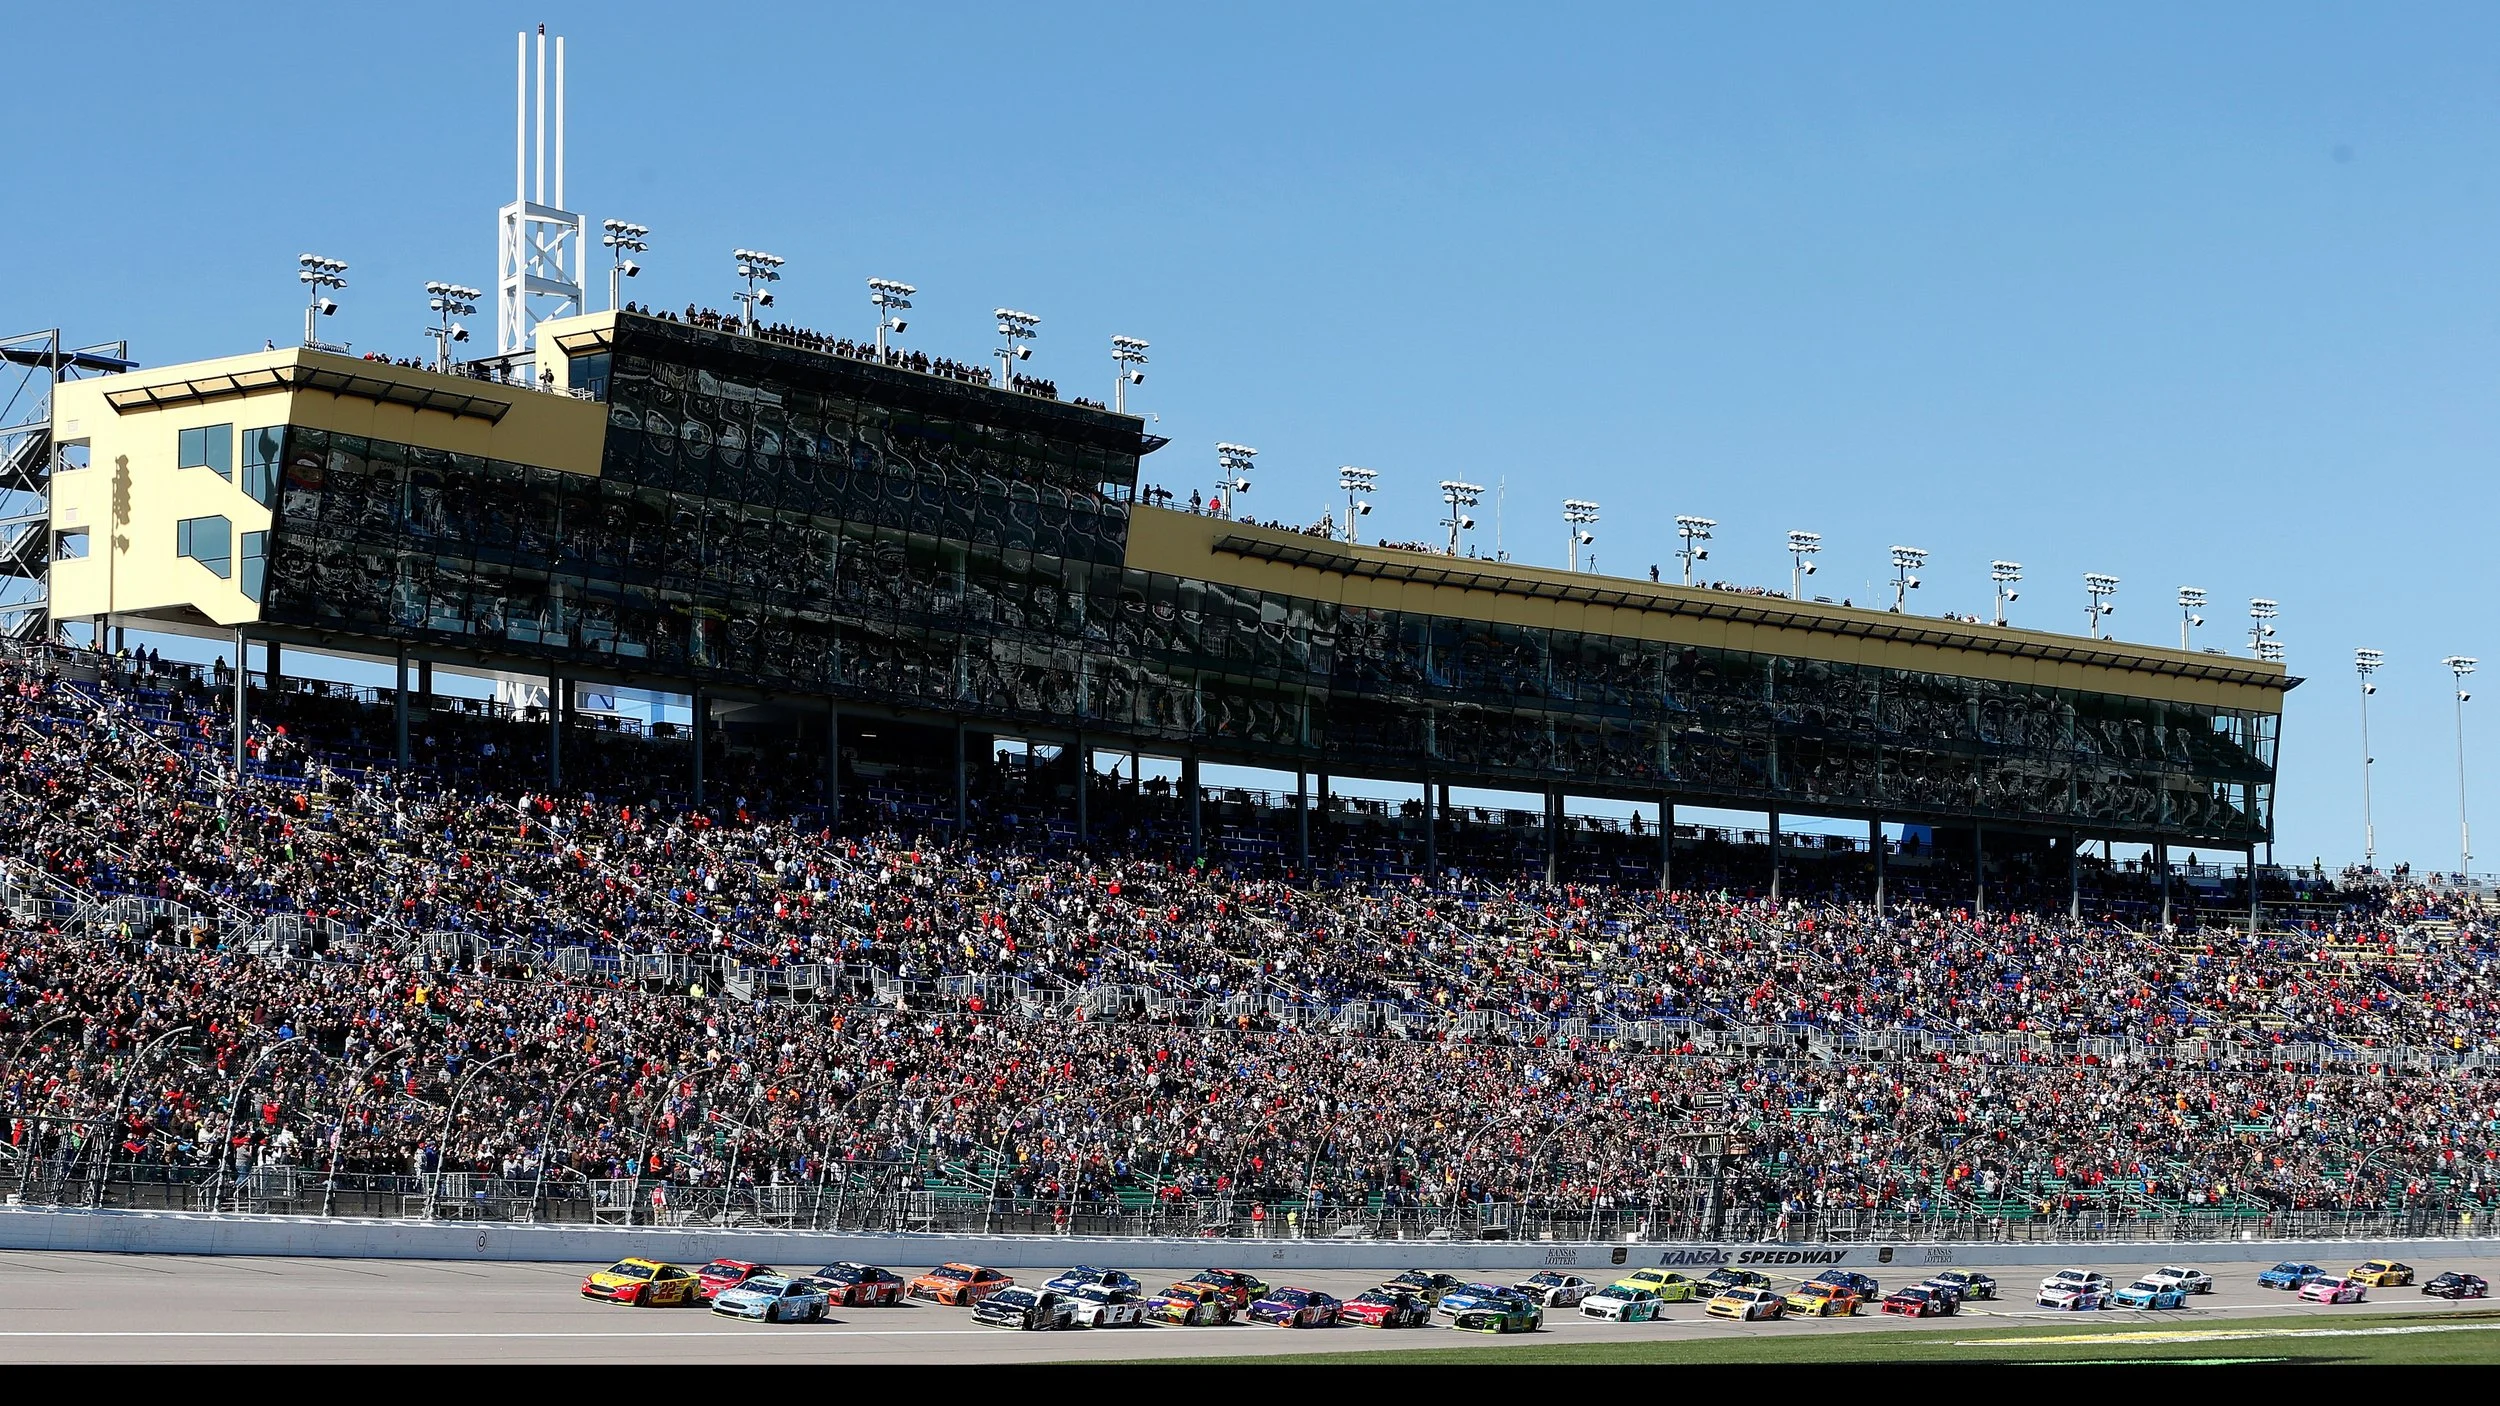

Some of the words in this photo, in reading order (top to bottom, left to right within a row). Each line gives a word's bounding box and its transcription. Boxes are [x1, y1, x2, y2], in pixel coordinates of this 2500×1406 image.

[1659, 1247, 1733, 1265] KANSAS
[1737, 1250, 1849, 1264] SPEEDWAY
[1927, 1248, 1953, 1256] KANSAS
[1544, 1257, 1578, 1265] LOTTERY
[658, 1281, 677, 1299] 22
[864, 1285, 878, 1301] 20
[1566, 1288, 1576, 1303] 31
[790, 1299, 802, 1317] 4
[1114, 1306, 1125, 1321] 2
[1203, 1305, 1214, 1319] 18
[1933, 1301, 1941, 1312] 3
[1399, 1309, 1411, 1323] 41
